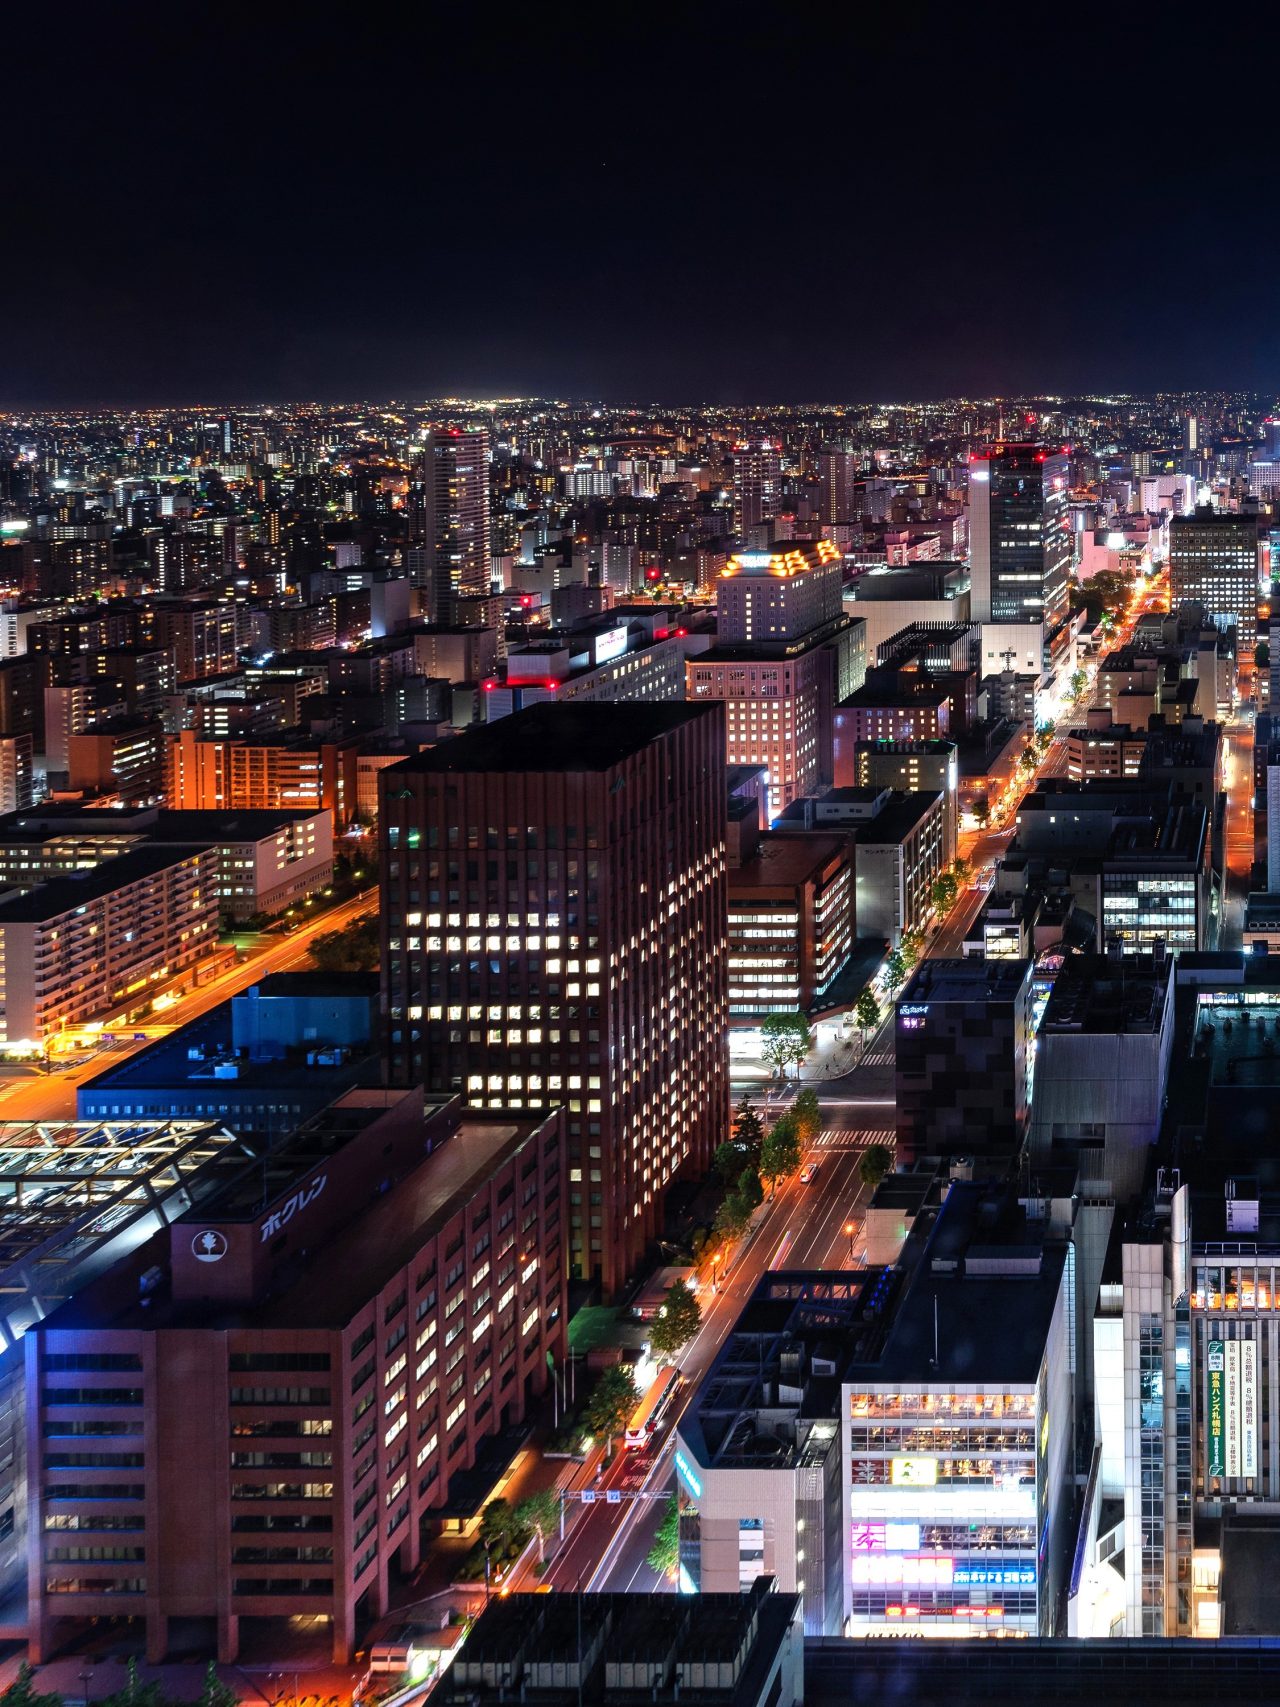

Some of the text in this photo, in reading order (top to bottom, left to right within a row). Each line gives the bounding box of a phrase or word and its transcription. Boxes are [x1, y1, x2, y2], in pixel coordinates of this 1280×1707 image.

[260, 1174, 327, 1243] ホクレン
[1211, 1372, 1221, 1436] 東急ハンズ札幌店
